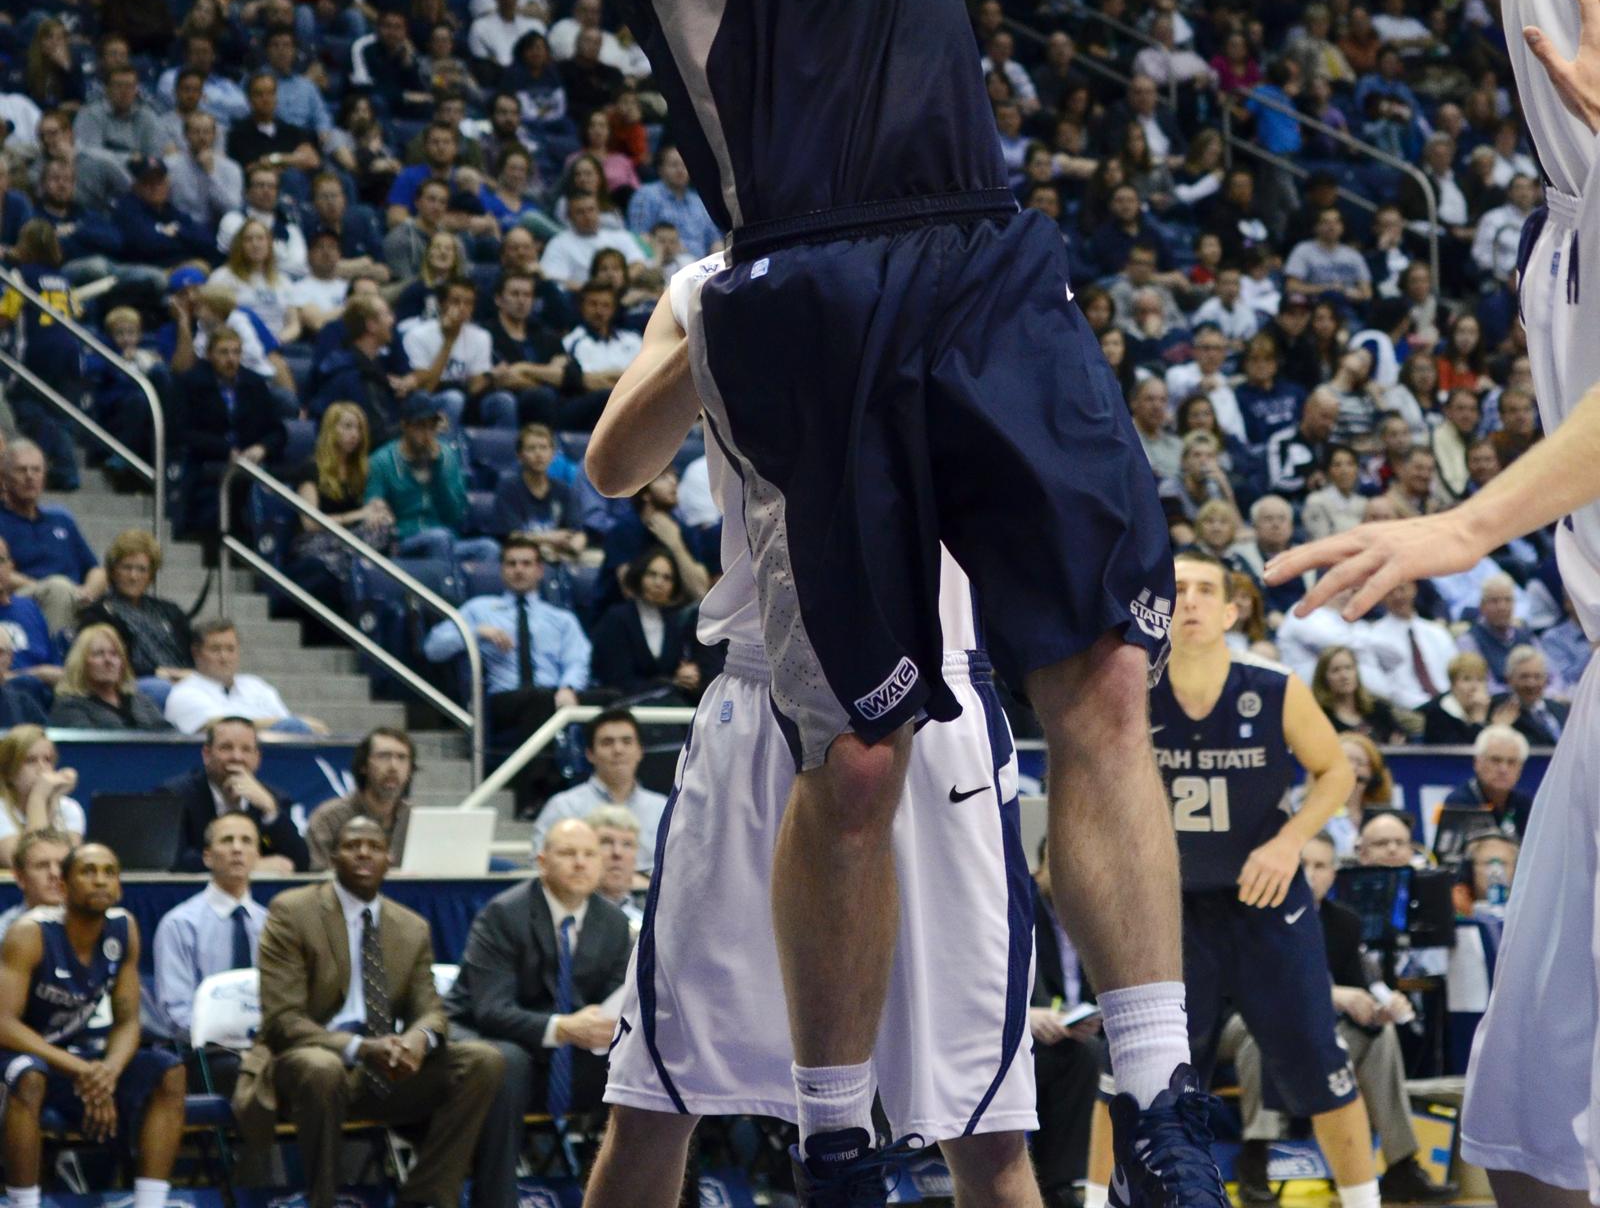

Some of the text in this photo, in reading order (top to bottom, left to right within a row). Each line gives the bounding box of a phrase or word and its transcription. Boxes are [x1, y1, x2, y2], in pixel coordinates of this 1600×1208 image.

[1130, 599, 1172, 630] STATE
[859, 660, 916, 717] WAC
[1197, 747, 1267, 770] STATE
[1172, 775, 1231, 832] 21
